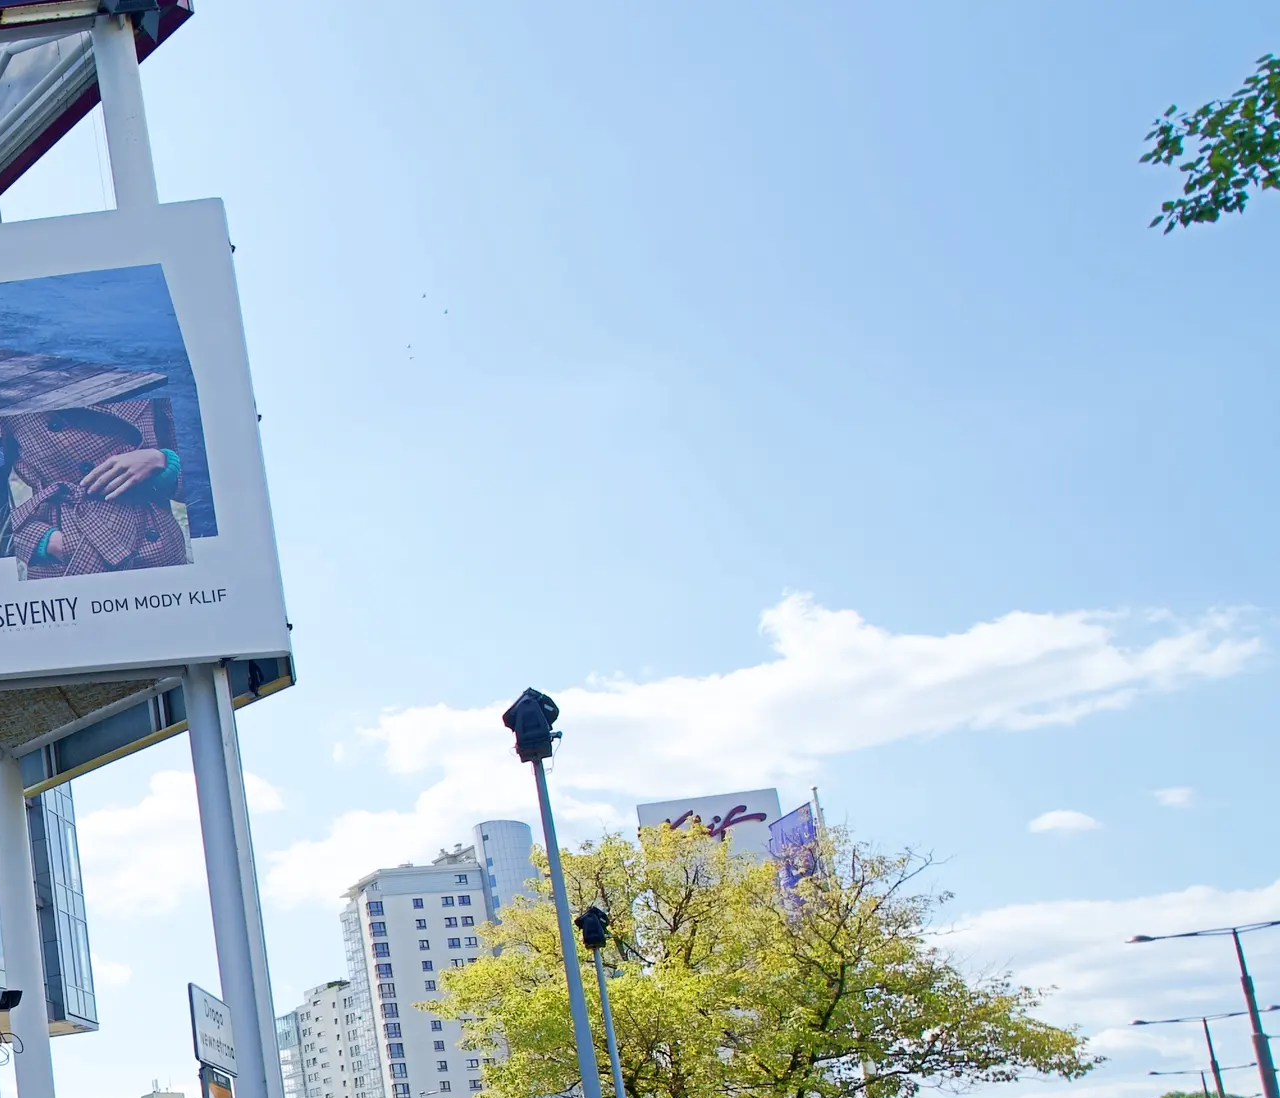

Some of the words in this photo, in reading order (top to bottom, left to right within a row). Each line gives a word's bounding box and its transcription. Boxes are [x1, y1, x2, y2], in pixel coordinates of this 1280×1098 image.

[92, 599, 129, 614] DOM
[135, 593, 183, 610] MODY
[189, 588, 227, 605] KLIF
[204, 999, 224, 1029] Droga
